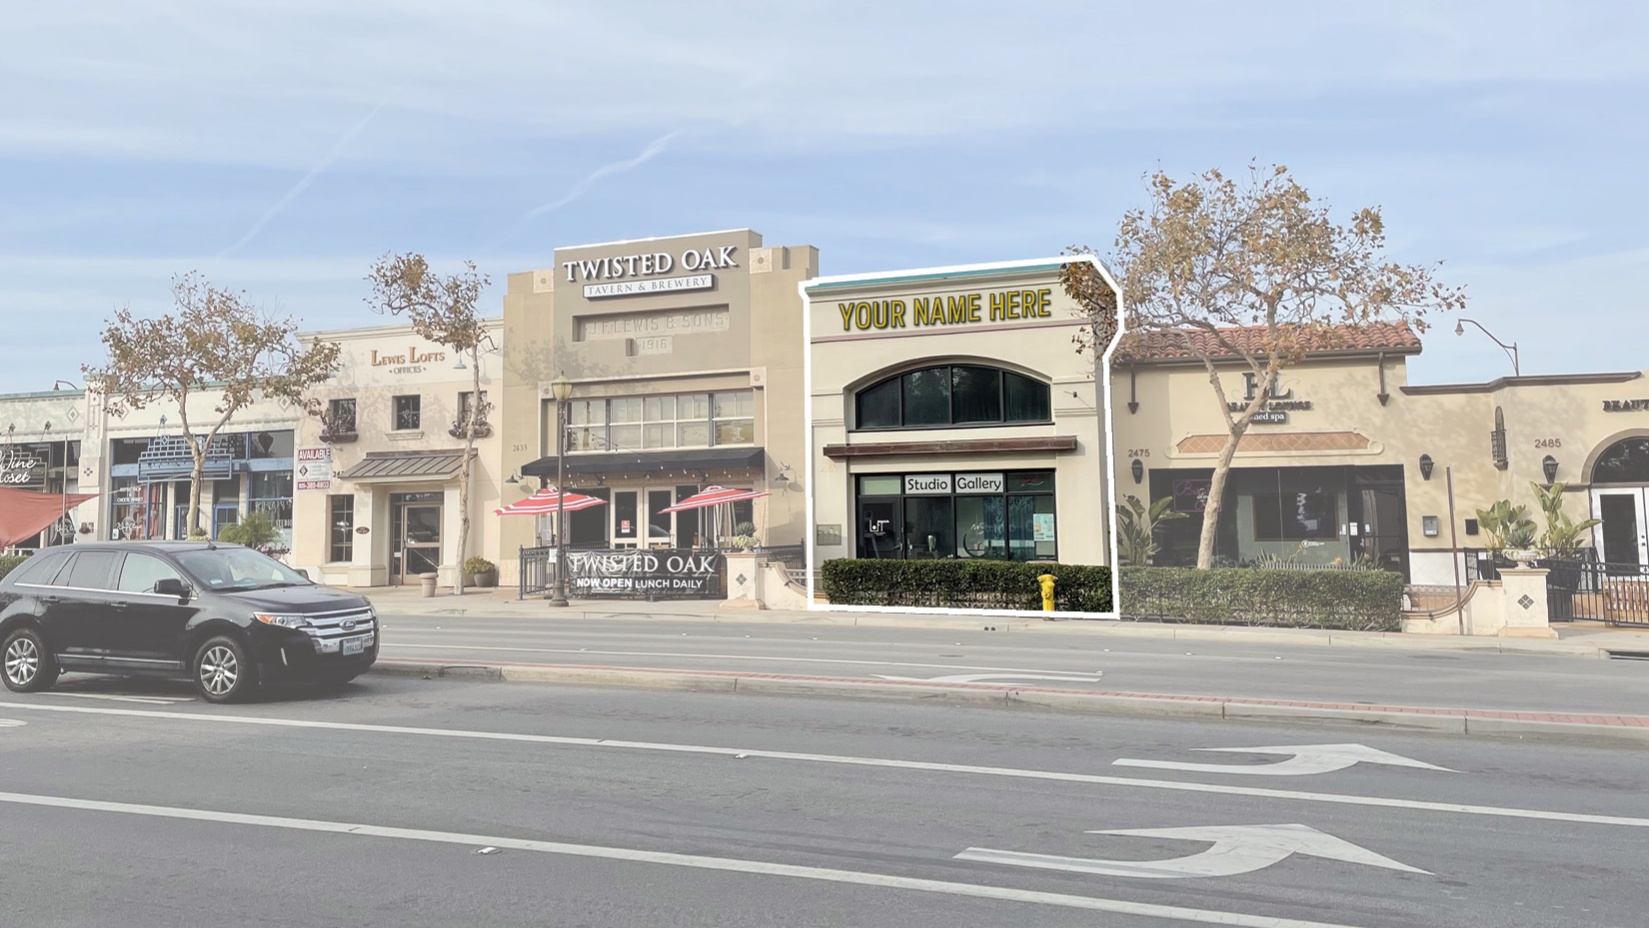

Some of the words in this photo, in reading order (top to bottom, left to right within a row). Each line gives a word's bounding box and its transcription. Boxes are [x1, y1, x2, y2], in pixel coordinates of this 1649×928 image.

[563, 252, 673, 282] TWISTED
[681, 246, 738, 271] OAK
[588, 284, 633, 296] TAVERN
[638, 282, 646, 291] &
[652, 276, 708, 290] BREWERY
[839, 300, 906, 331] YOUR
[914, 293, 981, 326] NAME
[989, 288, 1052, 321] HERE
[666, 317, 675, 329] &
[682, 312, 725, 328] SONS
[1270, 413, 1285, 422] spa
[1534, 438, 1562, 449] 2485
[298, 448, 331, 460] AVAILABLE
[1128, 448, 1150, 458] 2475
[907, 478, 948, 491] Studio
[957, 477, 1002, 491] Gallery
[569, 555, 659, 573] TWISTED
[666, 555, 715, 573] OAK
[576, 577, 600, 588] NOW
[602, 577, 633, 588] OPEN
[635, 579, 670, 589] LUNCH
[673, 579, 703, 589] DAILY
